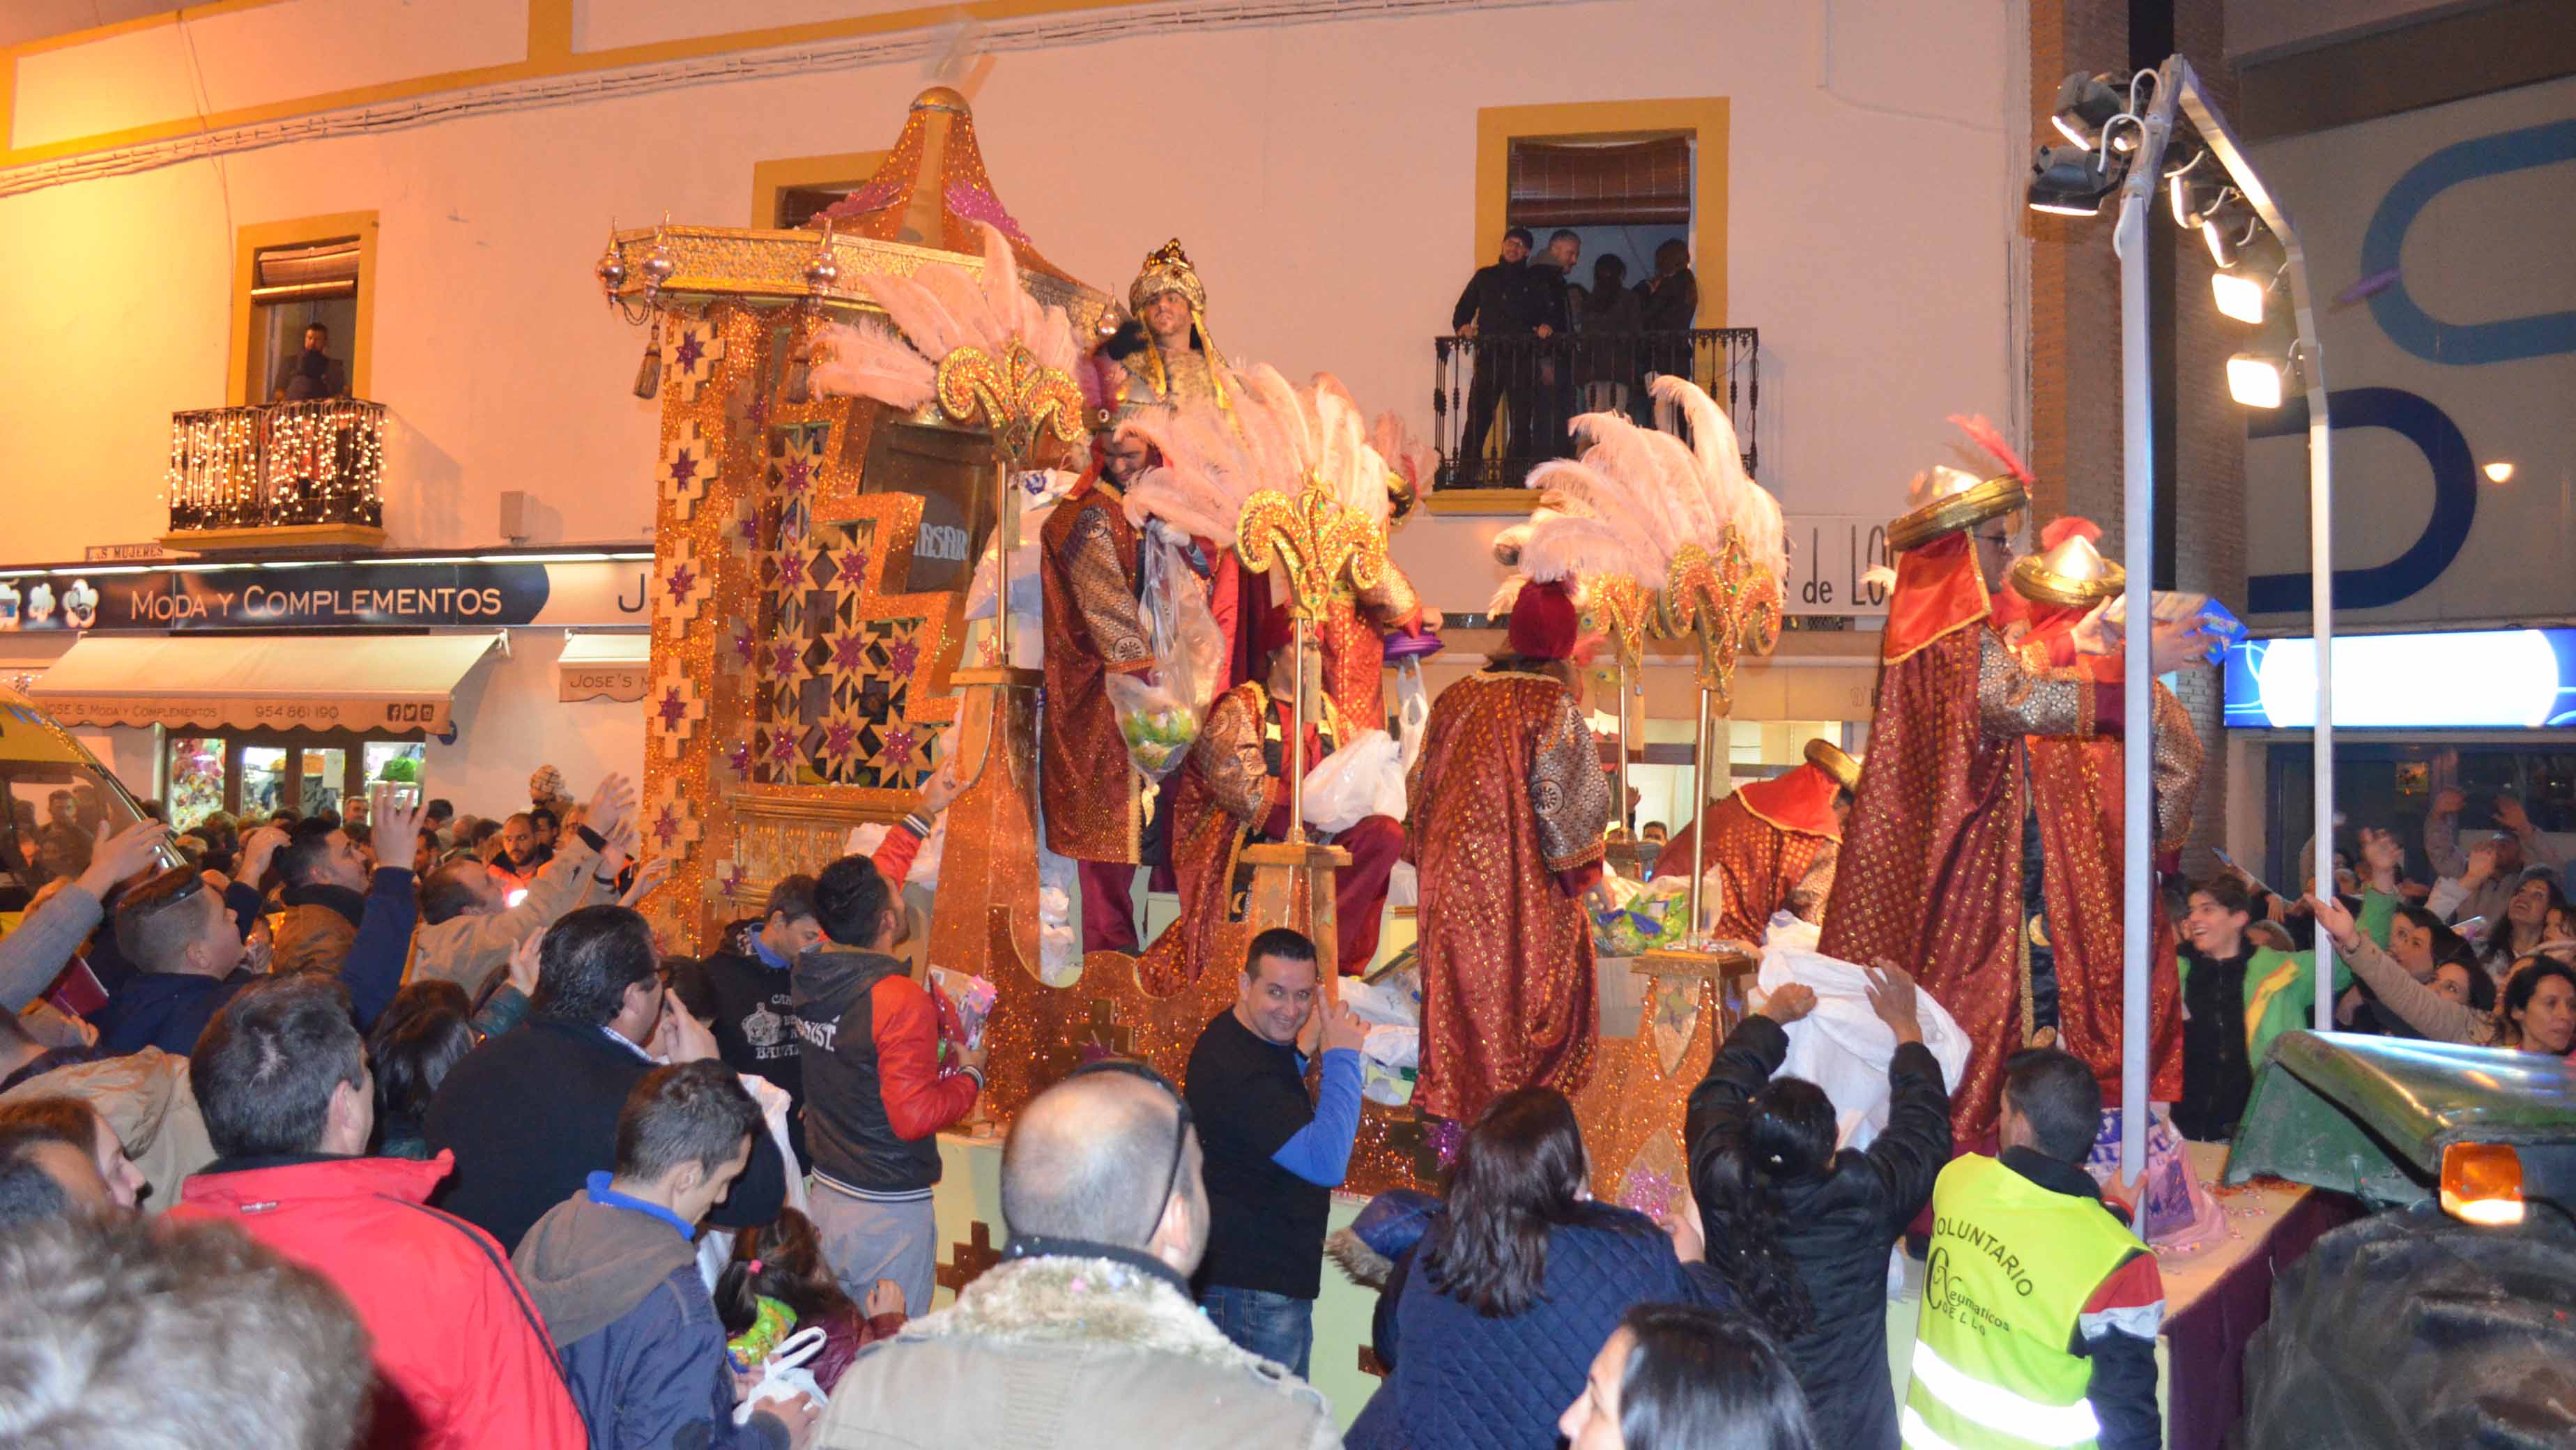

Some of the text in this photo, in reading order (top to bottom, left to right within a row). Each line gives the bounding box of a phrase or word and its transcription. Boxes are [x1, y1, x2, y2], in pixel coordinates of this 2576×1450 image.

[1802, 527, 1833, 605] de
[130, 585, 503, 620] MODA Y COMPLEMENTOS
[569, 673, 633, 688] JOSE'S
[255, 705, 282, 718] 954
[315, 705, 339, 719] 190
